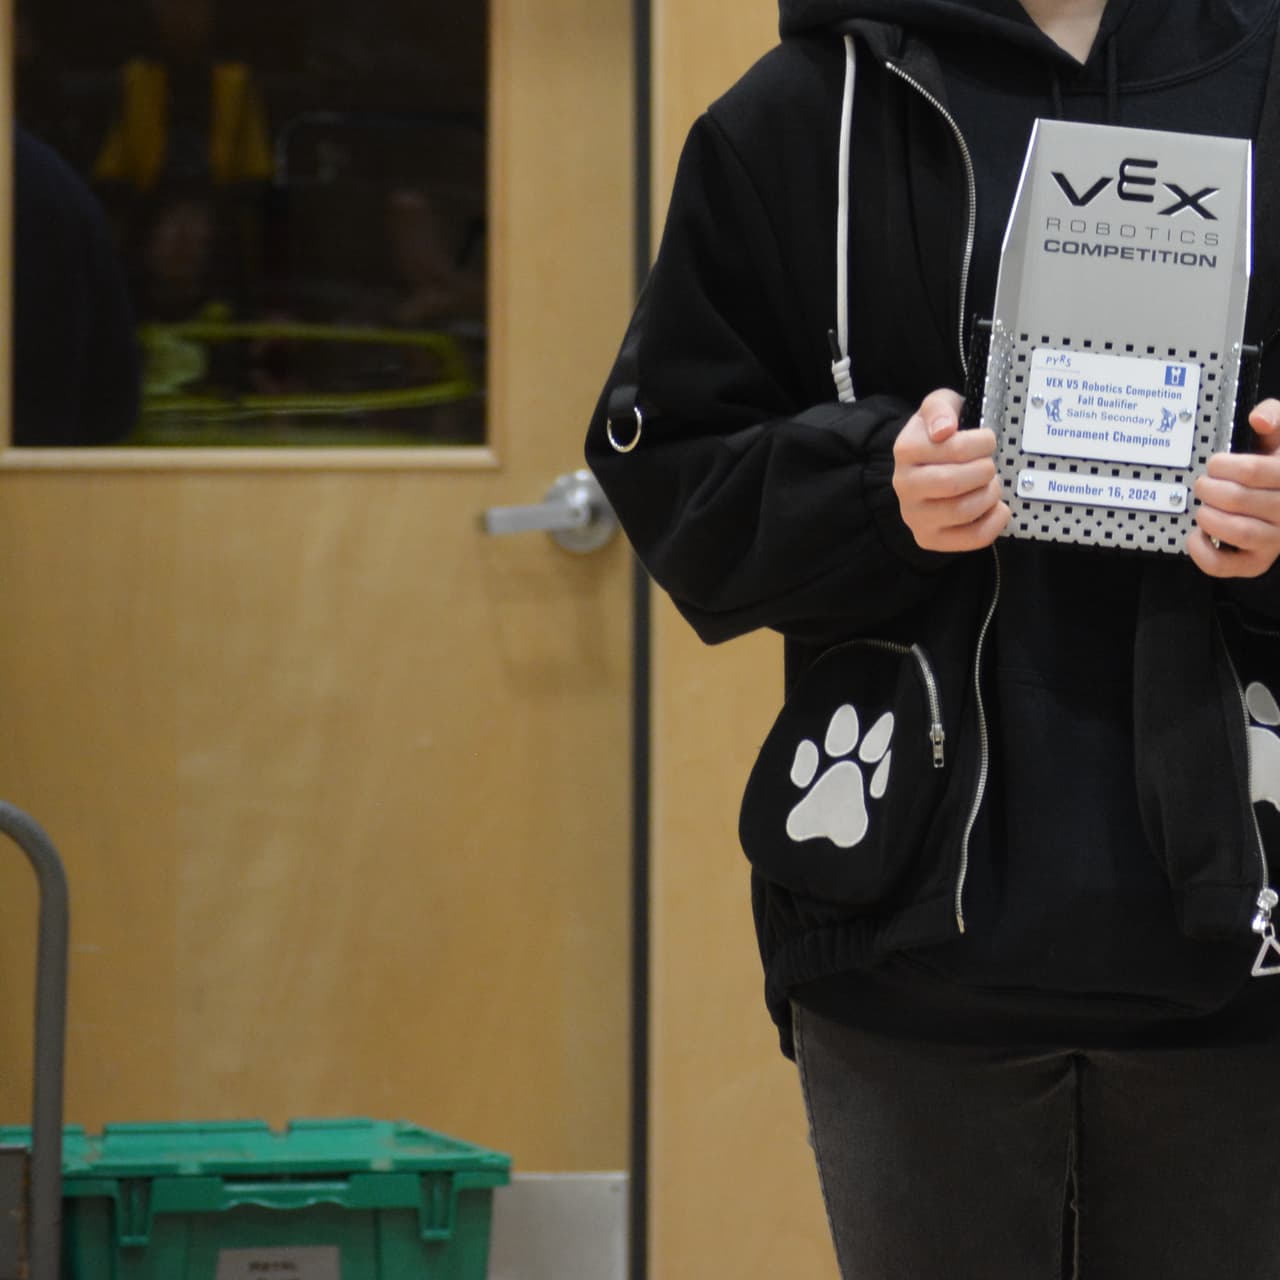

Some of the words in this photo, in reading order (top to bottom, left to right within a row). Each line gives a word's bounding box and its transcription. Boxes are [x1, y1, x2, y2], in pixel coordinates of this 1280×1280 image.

[1051, 157, 1221, 220] VEX
[1045, 217, 1220, 246] ROBOTICS
[1043, 239, 1218, 268] COMPETITION
[1046, 377, 1064, 389] VEX
[1067, 380, 1079, 390] V5
[1082, 381, 1123, 394] Robotics
[1126, 385, 1183, 400] Competition
[1078, 394, 1095, 406] Fall
[1097, 397, 1138, 410] Qualifier
[1066, 408, 1098, 420] Salish
[1101, 412, 1155, 426] Secondary
[1046, 424, 1109, 441] Tournament
[1113, 431, 1171, 447] Champions
[1048, 480, 1104, 495] November
[1108, 486, 1124, 500] 16,
[1128, 488, 1157, 501] 2024
